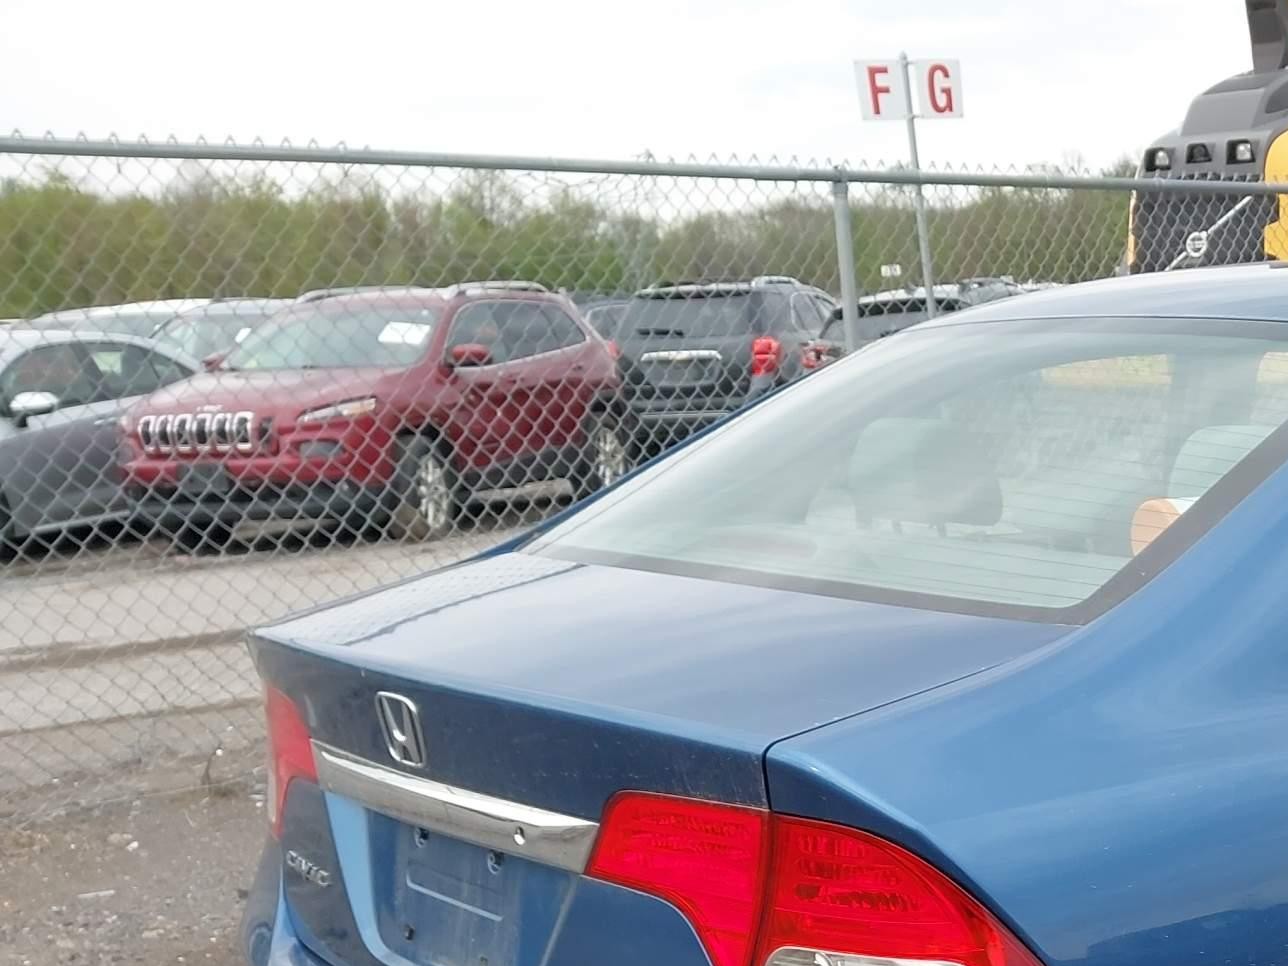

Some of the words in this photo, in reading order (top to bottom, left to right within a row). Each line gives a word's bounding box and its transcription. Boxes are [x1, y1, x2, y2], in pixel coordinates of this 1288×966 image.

[867, 65, 890, 115] F
[928, 63, 953, 114] G
[286, 849, 330, 887] CIVIC
